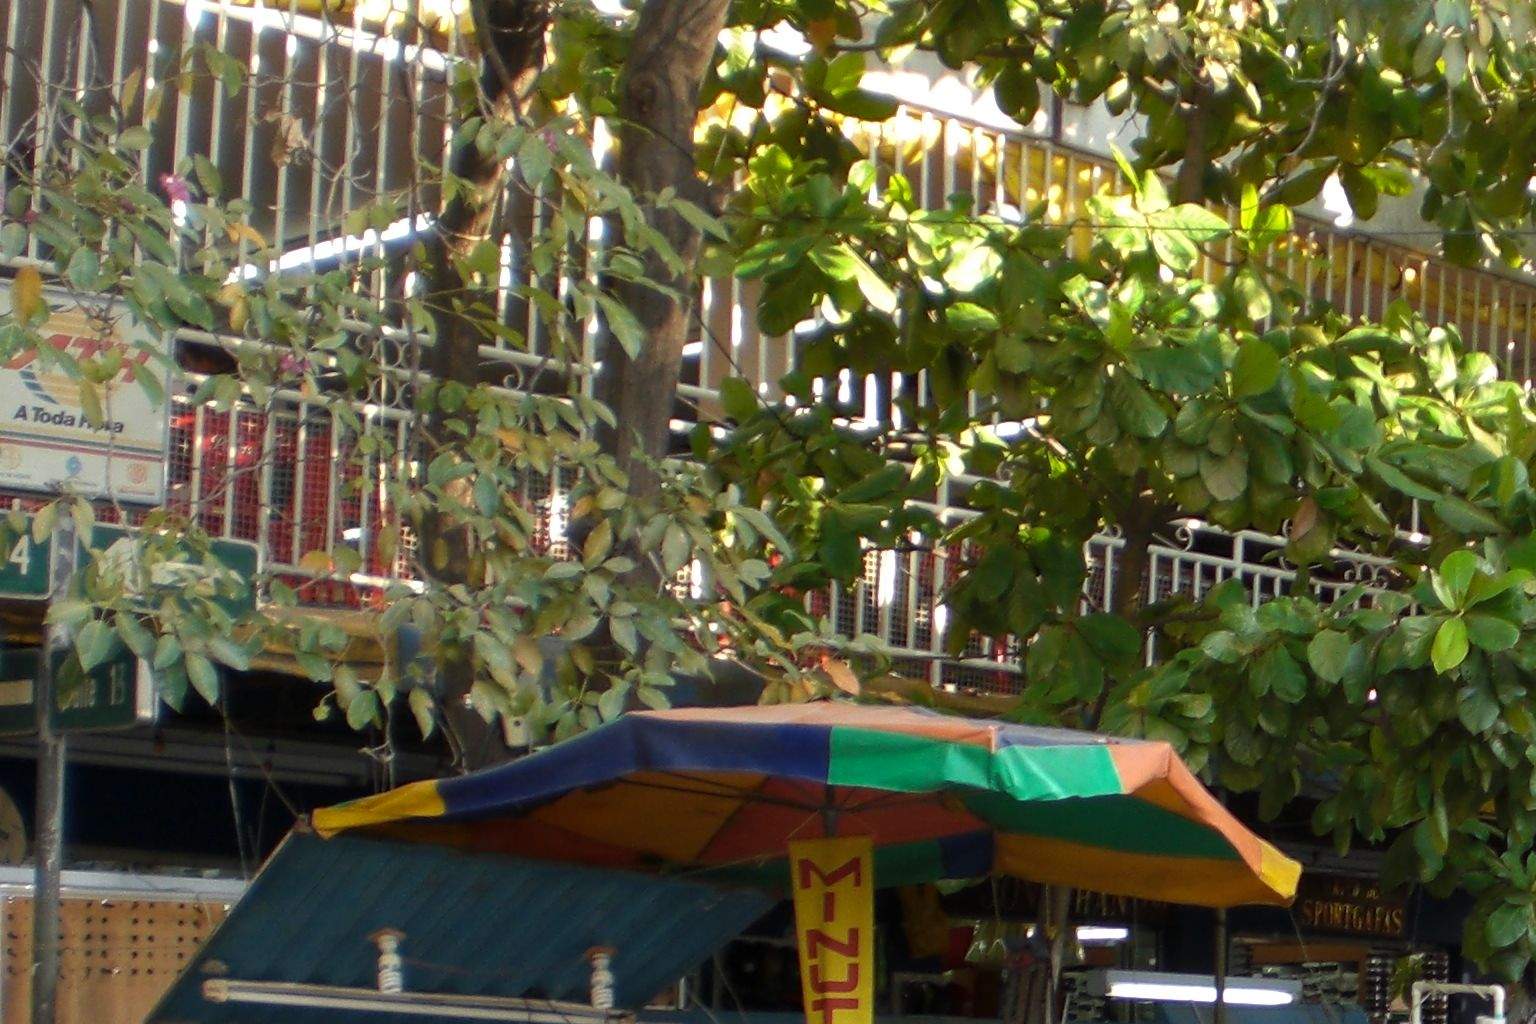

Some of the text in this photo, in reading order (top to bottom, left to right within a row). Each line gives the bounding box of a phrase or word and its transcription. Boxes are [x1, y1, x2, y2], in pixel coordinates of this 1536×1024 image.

[14, 405, 28, 421] A
[32, 406, 76, 428] Toda
[9, 535, 29, 576] 4
